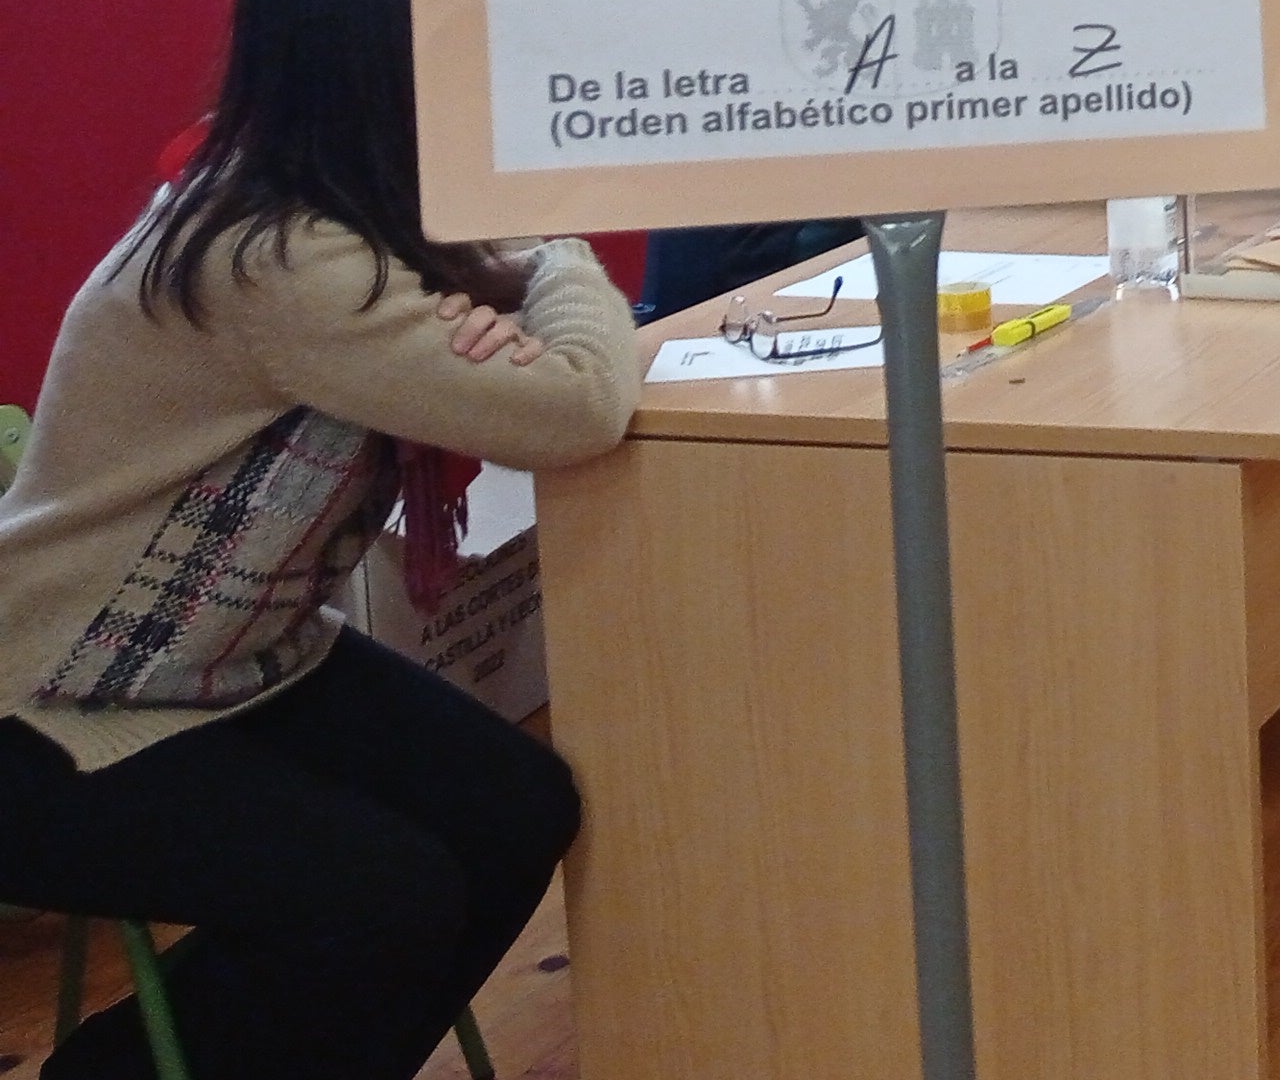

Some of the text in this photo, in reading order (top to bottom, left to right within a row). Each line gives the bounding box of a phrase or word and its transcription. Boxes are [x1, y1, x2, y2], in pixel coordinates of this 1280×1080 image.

[549, 14, 1123, 103] De la letra A a la Z
[550, 80, 1194, 148] (Orden alfabético primer apellido)
